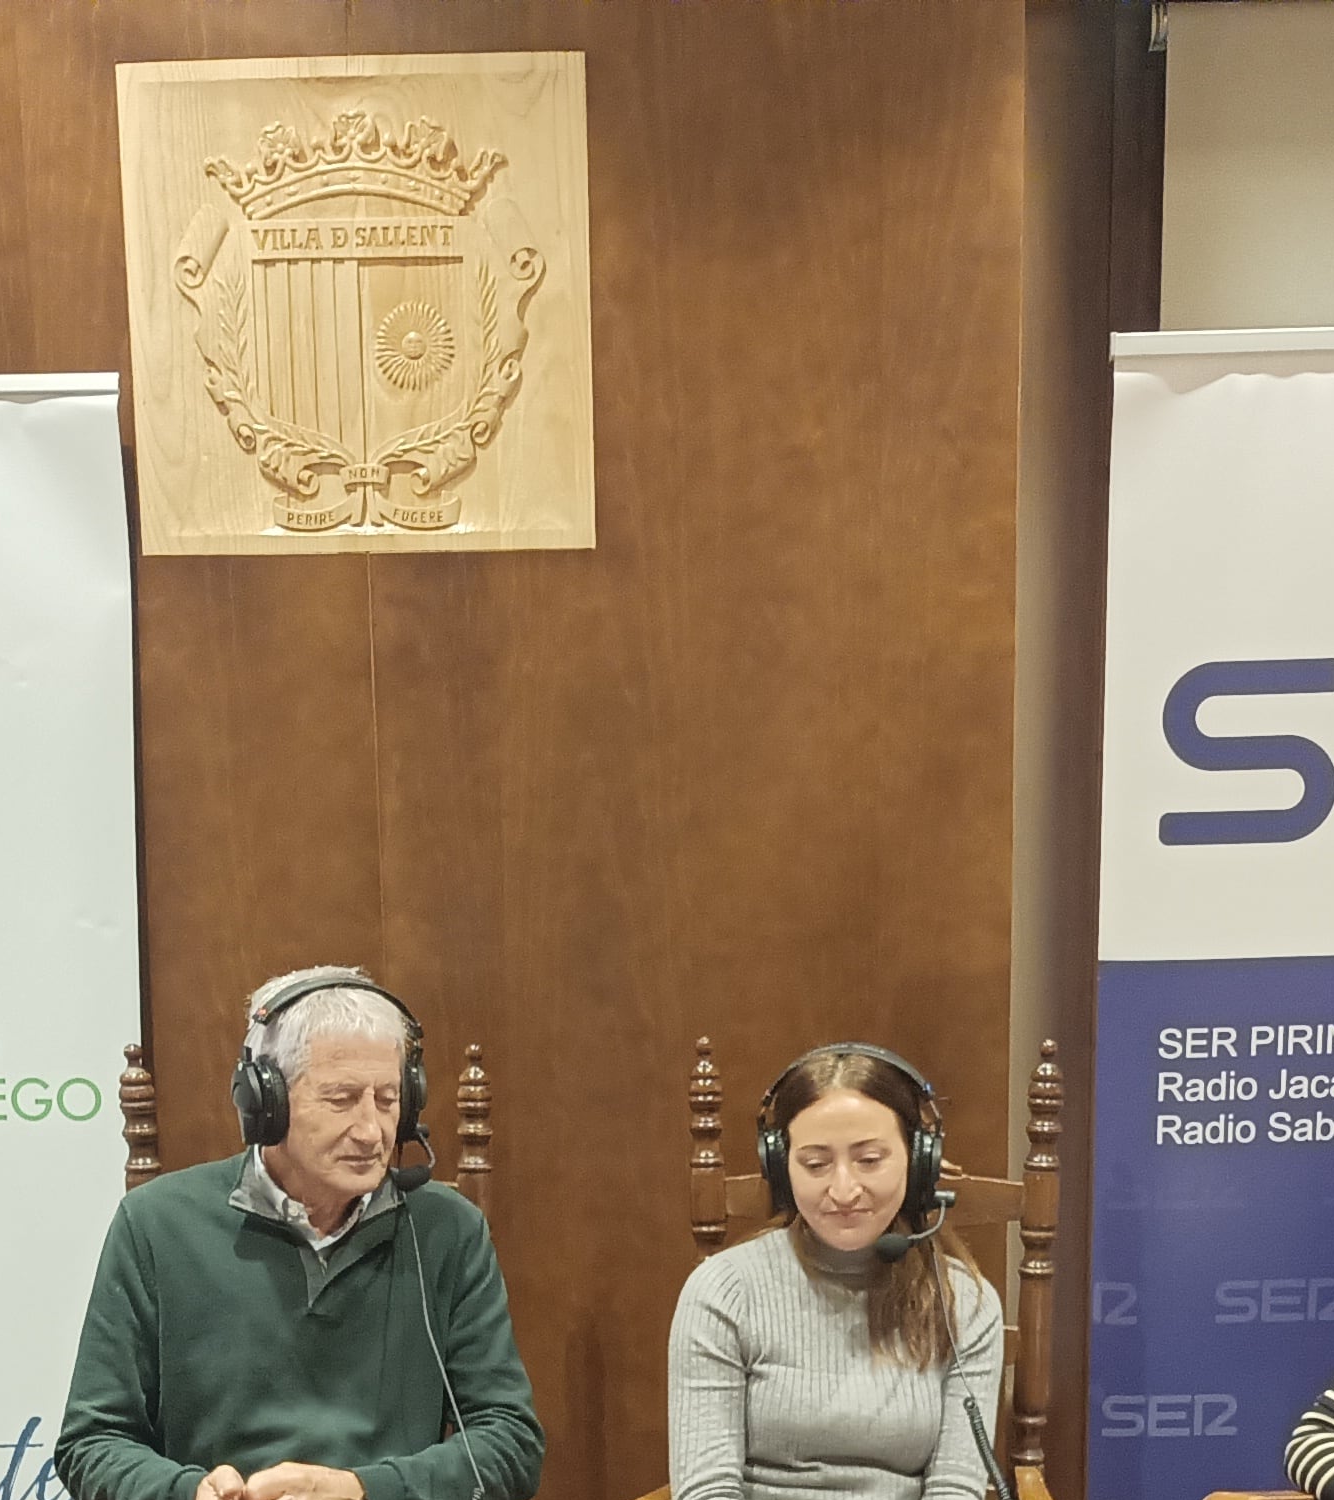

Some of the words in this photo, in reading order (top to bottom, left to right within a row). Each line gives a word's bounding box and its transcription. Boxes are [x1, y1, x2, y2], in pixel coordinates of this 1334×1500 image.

[251, 227, 323, 251] VILLA
[355, 224, 454, 248] SALLENT
[287, 511, 336, 526] PERIRE
[392, 508, 444, 524] FUGERE
[1158, 1026, 1238, 1060] SER
[1157, 1071, 1258, 1102] Radio
[1156, 1113, 1257, 1145] Radio
[1101, 1393, 1238, 1437] SER
